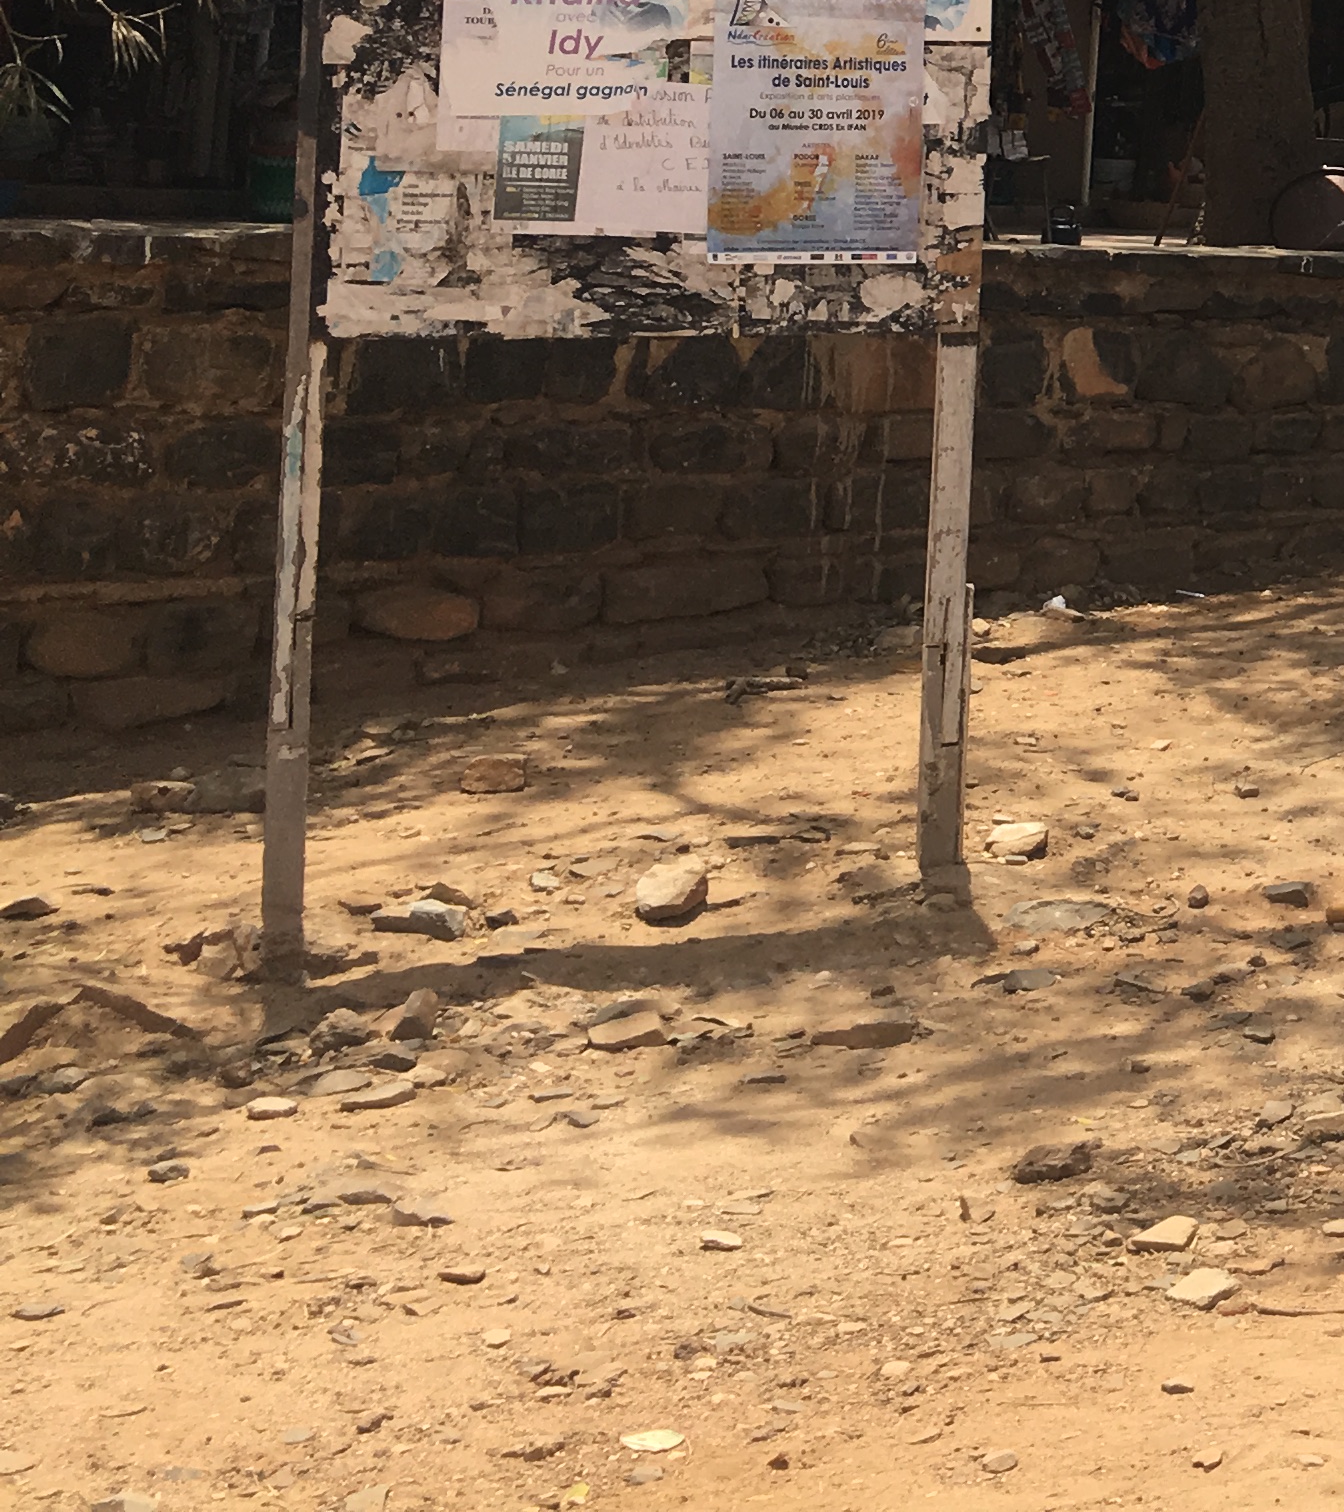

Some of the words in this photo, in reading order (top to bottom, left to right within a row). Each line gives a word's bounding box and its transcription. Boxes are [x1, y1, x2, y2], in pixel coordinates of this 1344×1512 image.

[556, 11, 597, 24] avec
[548, 29, 604, 60] Idy
[545, 64, 581, 77] Pour
[586, 66, 604, 77] un
[731, 54, 754, 69] Les
[758, 55, 829, 71] itinéraires
[833, 56, 907, 74] Artistiques
[772, 74, 791, 87] de
[795, 74, 870, 89] Saint-Louis
[494, 81, 572, 100] Sénégal
[760, 91, 805, 102] Exposition
[749, 108, 767, 120] Du
[769, 108, 784, 120] 06
[788, 110, 805, 120] au
[808, 108, 823, 120] 30
[827, 108, 852, 120] avril
[855, 109, 884, 121] 2019
[503, 140, 569, 153] SAMEDI
[502, 153, 512, 163] 5
[513, 153, 569, 166] JANVIER
[519, 167, 533, 179] DE
